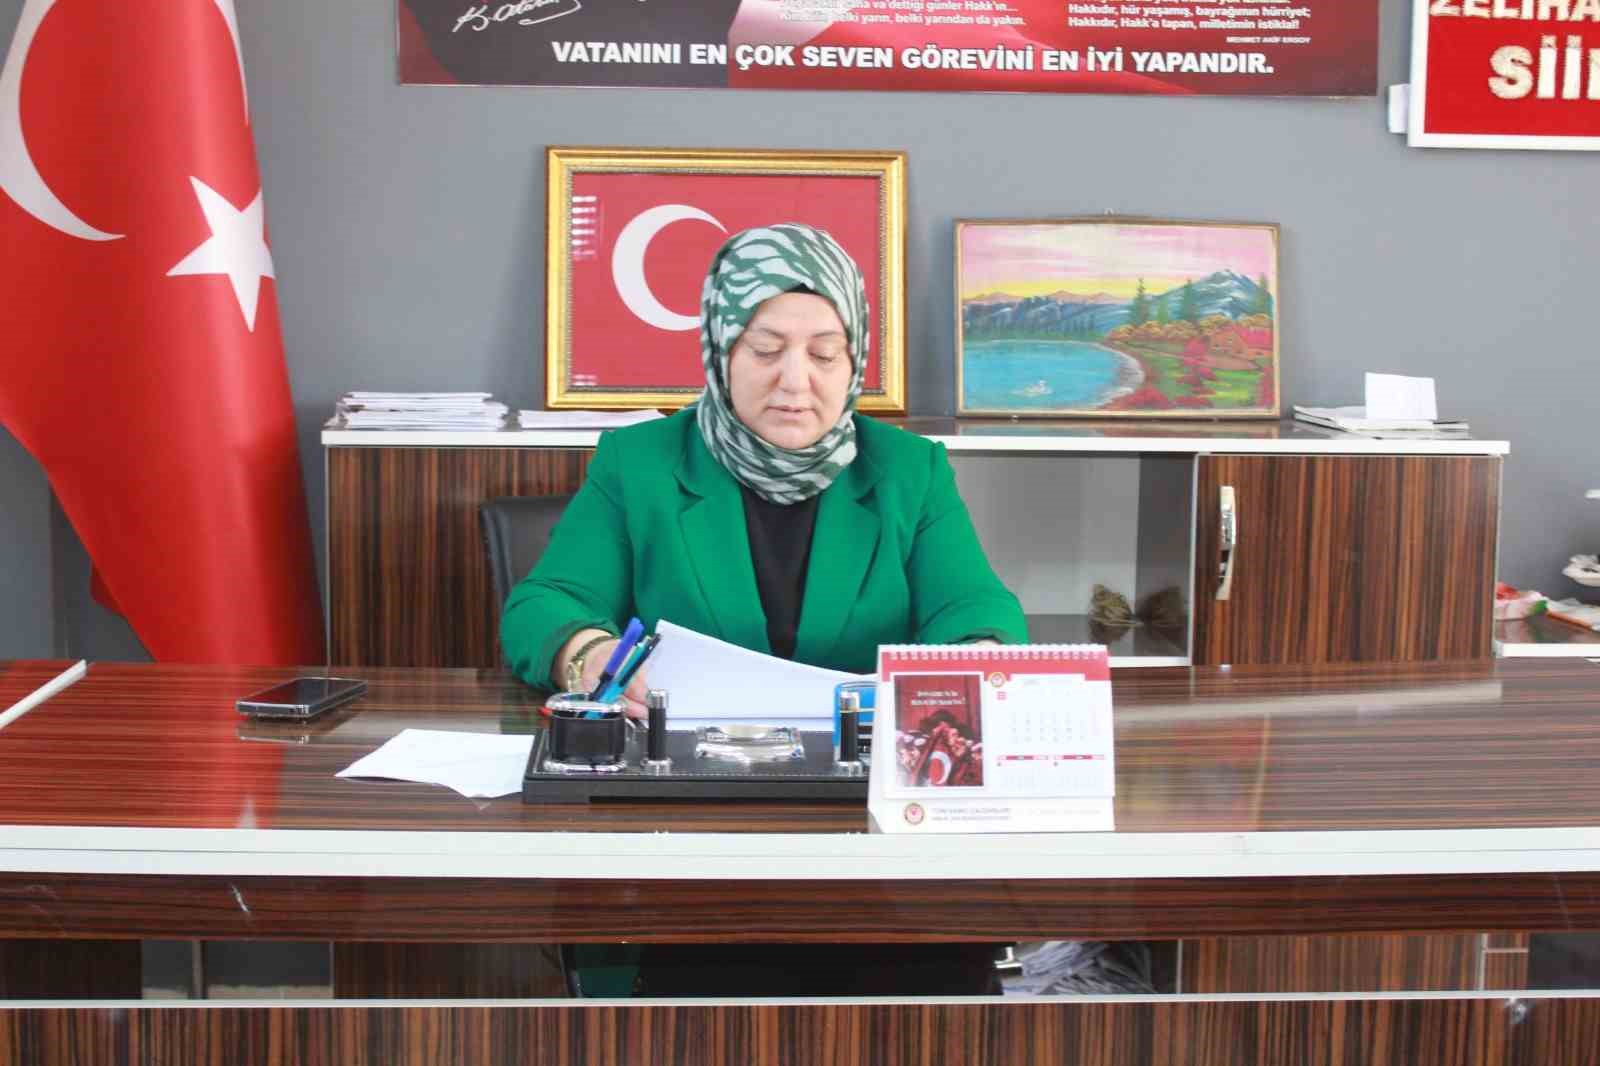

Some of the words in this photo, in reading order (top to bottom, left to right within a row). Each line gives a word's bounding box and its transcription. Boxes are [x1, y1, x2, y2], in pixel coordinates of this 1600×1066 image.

[896, 13, 922, 23] belki
[975, 15, 991, 25] da
[552, 41, 680, 65] VATANINI
[689, 44, 727, 65] EN
[735, 45, 795, 70] ÇOK
[801, 47, 894, 68] SEVEN
[902, 46, 1034, 70] GÖREVİNİ
[1042, 51, 1079, 71] EN
[1087, 47, 1123, 72] İYİ
[1131, 53, 1274, 74] YAPANDIR.
